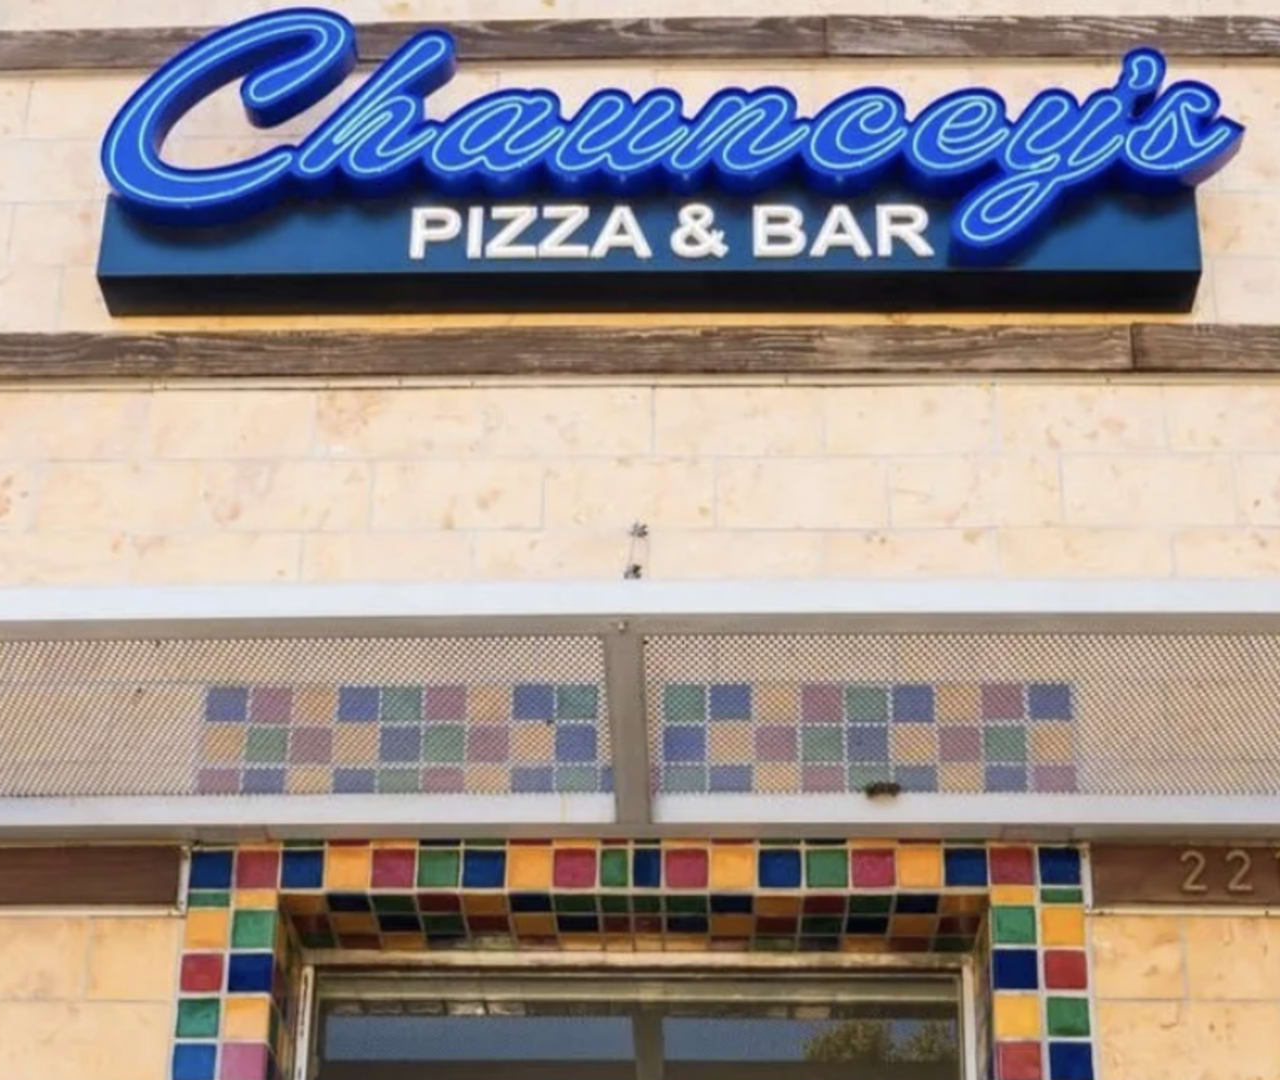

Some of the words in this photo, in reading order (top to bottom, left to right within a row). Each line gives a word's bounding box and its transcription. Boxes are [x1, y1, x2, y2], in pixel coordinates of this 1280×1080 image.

[103, 8, 1243, 252] Chauncey's
[408, 204, 653, 260] PIZZA
[669, 202, 728, 259] &
[752, 203, 935, 259] BAR
